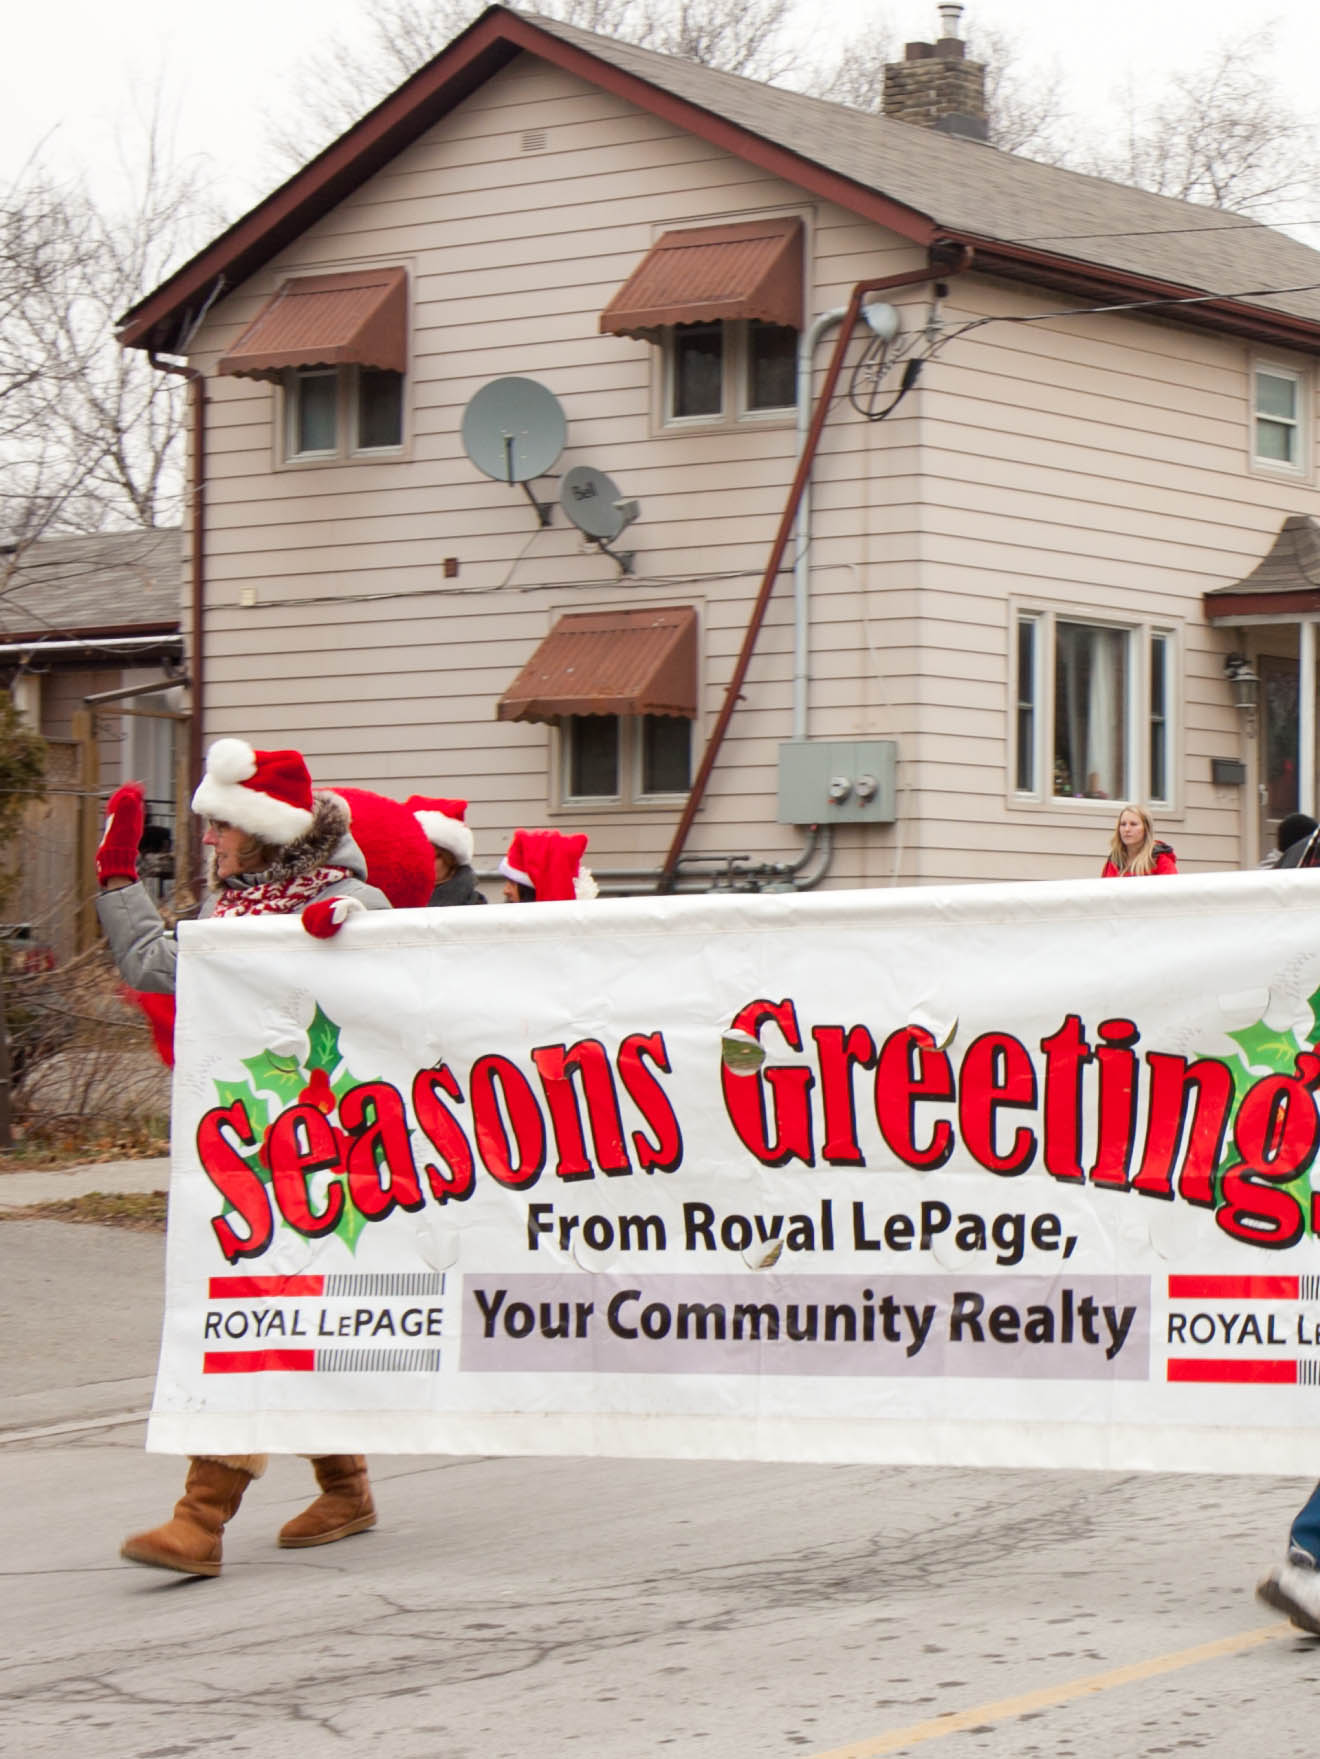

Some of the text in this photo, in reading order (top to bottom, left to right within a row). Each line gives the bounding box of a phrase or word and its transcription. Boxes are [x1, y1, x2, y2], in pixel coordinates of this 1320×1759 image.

[196, 1030, 684, 1264] Seasons
[527, 1202, 667, 1252] From
[852, 1200, 1078, 1266] LePage,
[203, 1309, 308, 1340] ROYAL
[473, 1289, 1137, 1361] Your Community Realty
[1167, 1313, 1286, 1345] ROYAL
